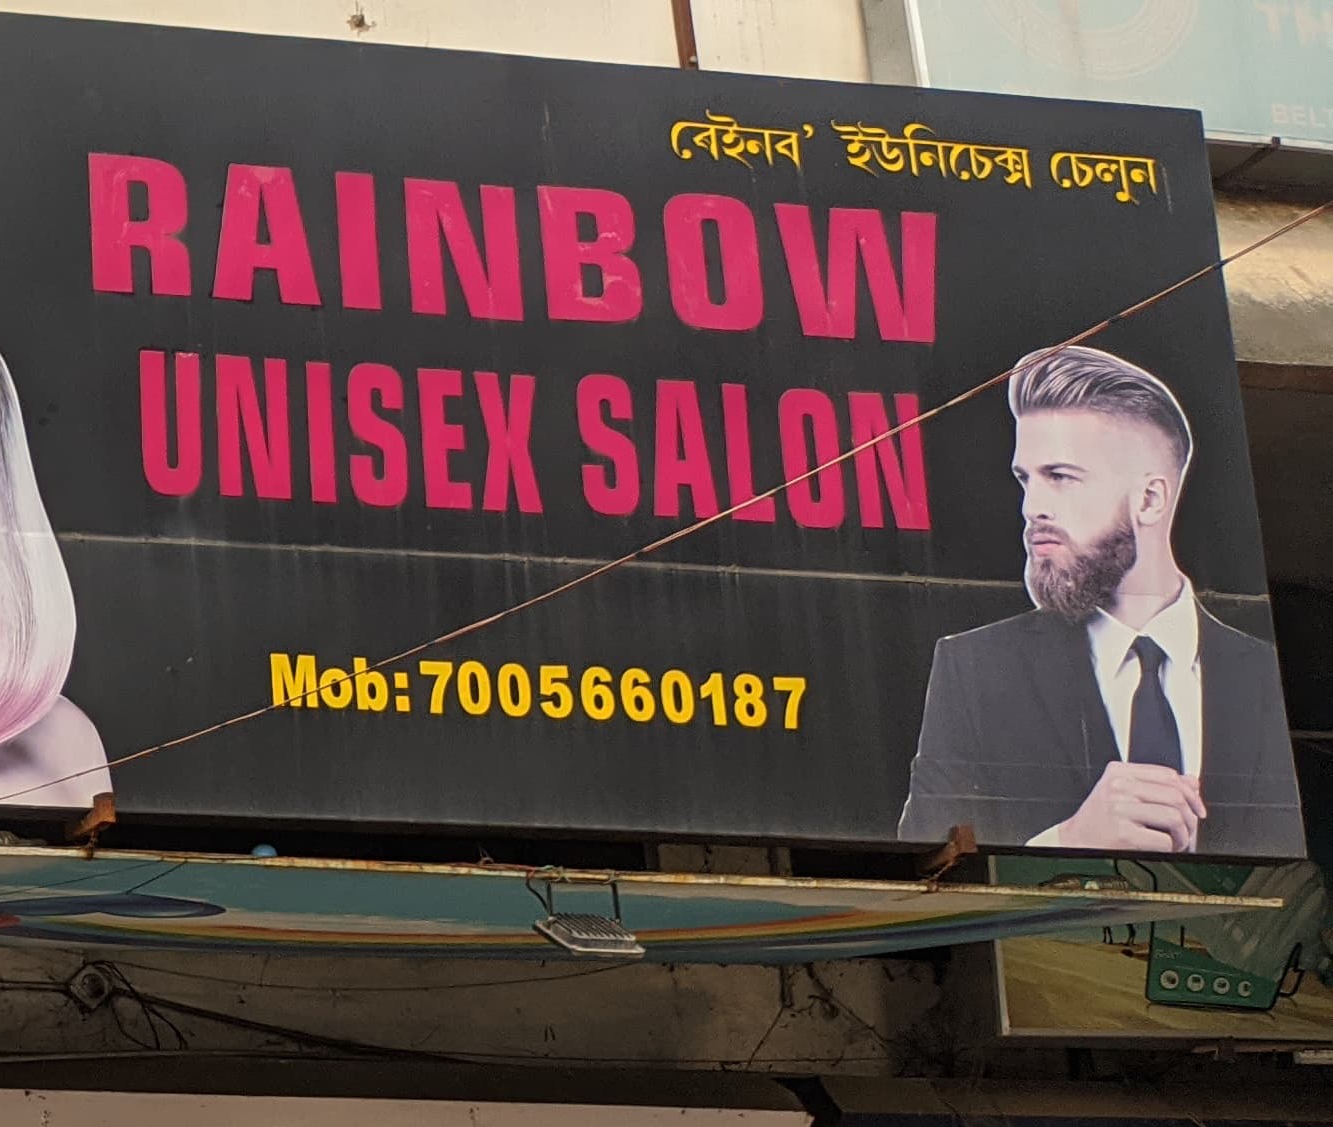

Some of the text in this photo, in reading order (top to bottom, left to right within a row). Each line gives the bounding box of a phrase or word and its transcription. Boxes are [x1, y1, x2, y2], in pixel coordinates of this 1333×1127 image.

[86, 151, 937, 344] RAINBOW
[1049, 150, 1158, 204] চেলুন
[139, 348, 932, 530] UNISEX SALON
